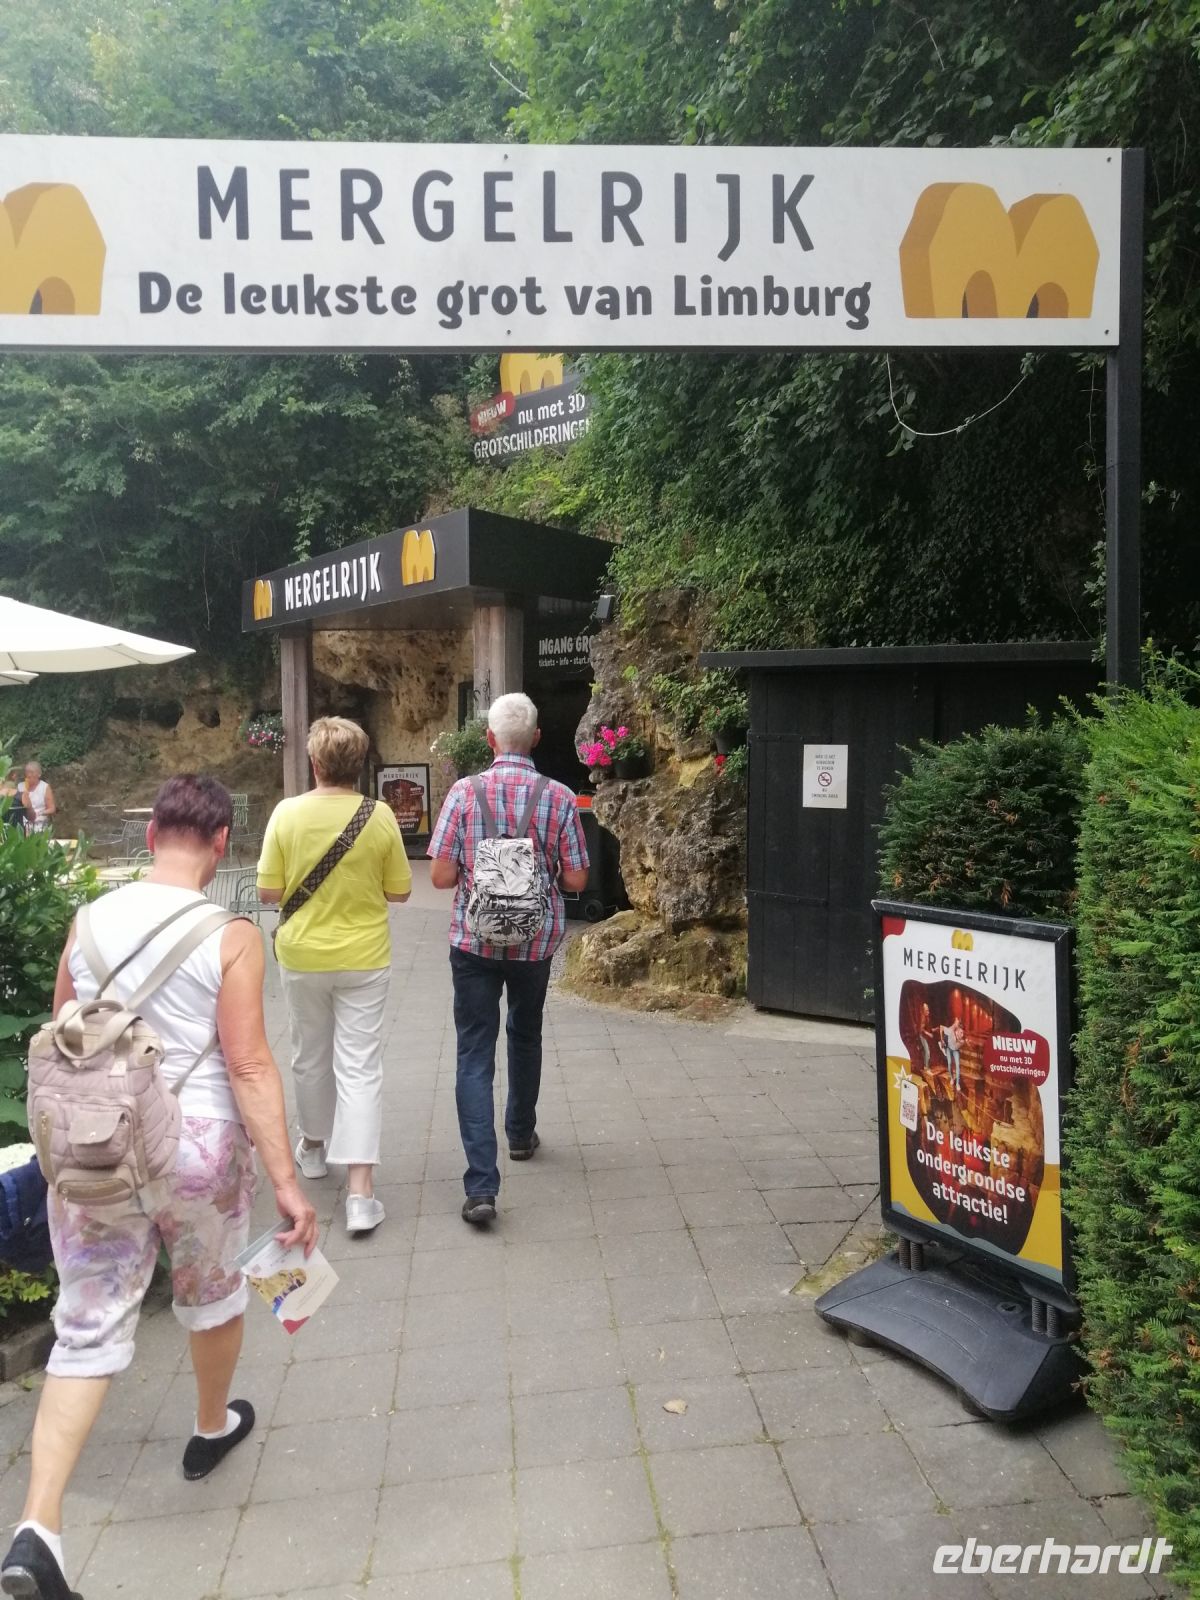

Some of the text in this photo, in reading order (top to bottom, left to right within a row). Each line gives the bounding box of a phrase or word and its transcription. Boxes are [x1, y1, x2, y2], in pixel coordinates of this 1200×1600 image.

[197, 164, 816, 262] MERGELRIJK
[138, 271, 872, 331] De leukste grot van Limburg
[477, 400, 507, 426] NIEUW
[518, 393, 586, 425] nu met 3D
[284, 551, 381, 611] MERGELRIJK
[539, 636, 574, 655] INGANG
[560, 656, 569, 666] info
[903, 947, 1026, 992] MERGELRIJK
[992, 1035, 1037, 1054] NIEUW
[999, 1055, 1033, 1065] nu met 3D
[990, 1063, 1046, 1078] grotschilderingen
[925, 1121, 1010, 1169] De leukste
[916, 1148, 1026, 1202] ondergrondse
[932, 1181, 1008, 1225] attractie!
